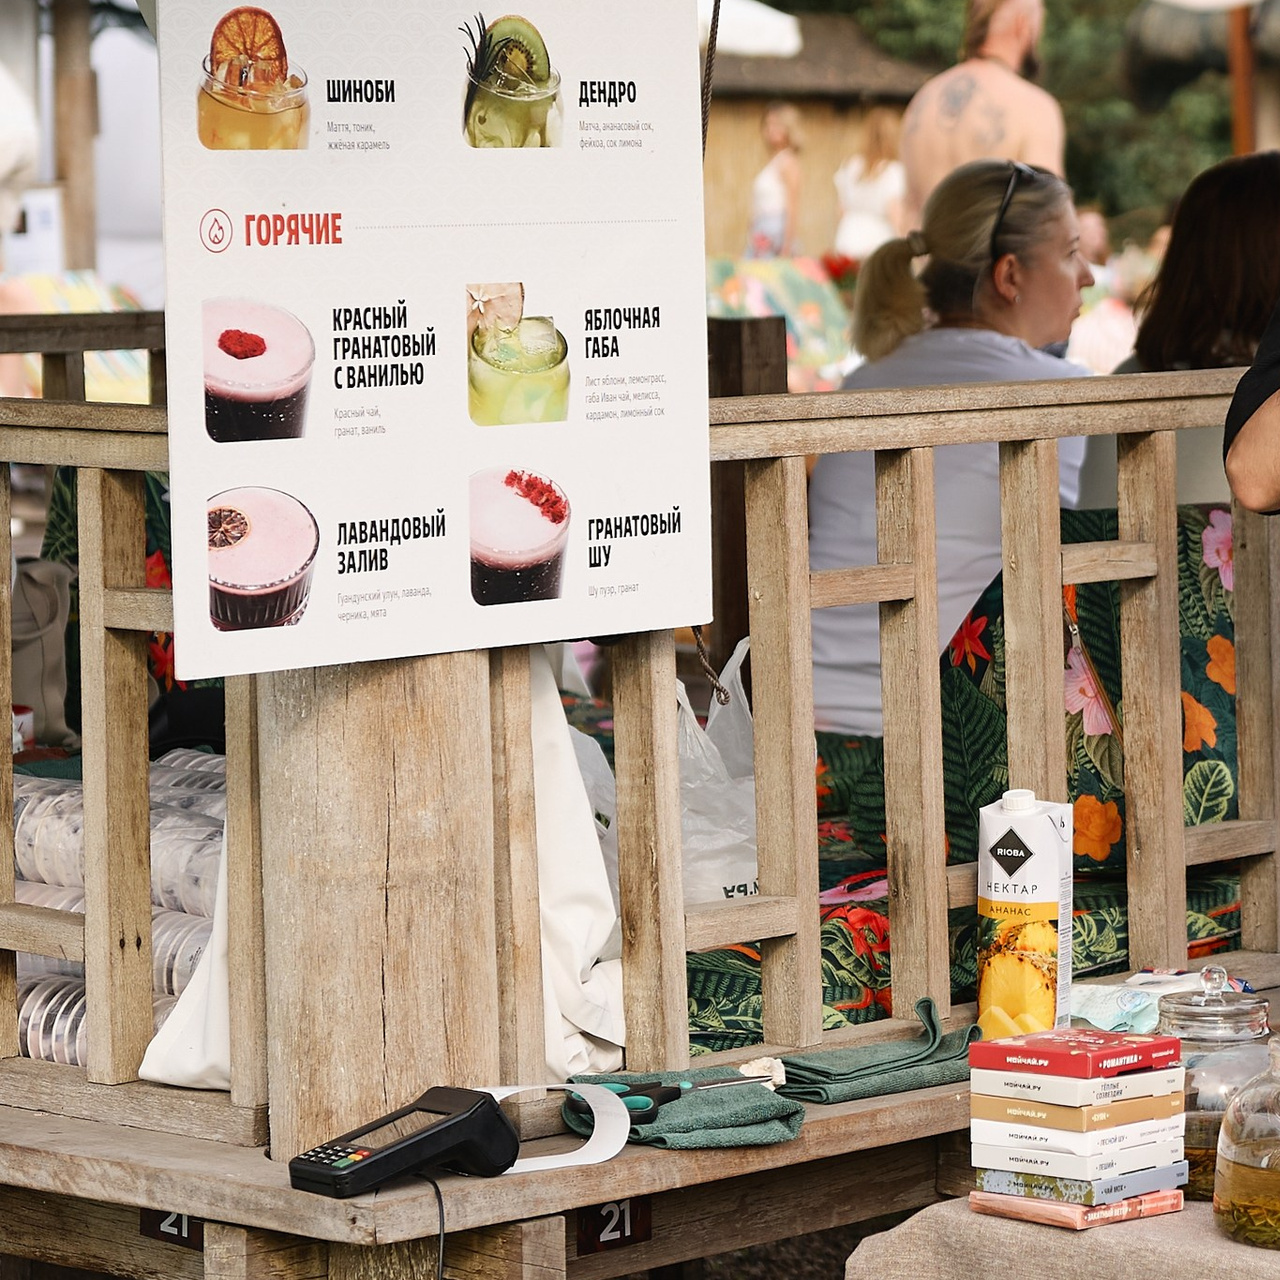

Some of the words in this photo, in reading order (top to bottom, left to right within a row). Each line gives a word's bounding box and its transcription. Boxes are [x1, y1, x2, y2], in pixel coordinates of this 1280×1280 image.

[326, 79, 395, 103] ШИНОБИ
[578, 81, 636, 108] ДЕНДРО
[352, 123, 375, 133] тоник,
[579, 121, 601, 133] Матча,
[602, 120, 640, 131] ананасовый
[641, 122, 654, 132] сок,
[328, 138, 355, 150] жжёная
[356, 141, 390, 152] карамель
[580, 137, 606, 151] фейхоа,
[606, 140, 617, 148] сок
[618, 140, 642, 148] лимона
[244, 211, 342, 247] ГОРЯЧИЕ
[333, 299, 407, 331] КРАСНЫЙ
[584, 306, 660, 331] ЯБЛОЧНАЯ
[333, 326, 436, 360] ГРАНАТОВЫЙ
[585, 335, 620, 359] ГАБА
[334, 366, 343, 389] С
[346, 362, 424, 388] ВАНИЛЬЮ
[585, 376, 600, 387] Лист
[601, 375, 627, 386] яблони,
[628, 374, 667, 386] лемонграсс,
[585, 392, 600, 403] габа
[601, 392, 617, 403] Иван
[618, 391, 631, 402] чай,
[632, 391, 661, 401] мелисса,
[334, 406, 365, 420] Красный
[366, 405, 381, 418] чай,
[585, 410, 619, 422] кардамон,
[620, 406, 653, 418] лимонный
[654, 407, 665, 416] сок
[334, 426, 360, 438] гранат,
[361, 425, 386, 435] ваниль
[337, 508, 445, 546] ЛАВАНДОВЫЙ
[588, 505, 681, 541] ГРАНАТОВЫЙ
[337, 548, 389, 575] ЗАЛИВ
[588, 545, 611, 568] ШУ
[337, 589, 381, 606] Гуандунский
[381, 590, 400, 602] улун,
[401, 587, 432, 598] лаванда,
[588, 586, 598, 598] Шу
[599, 586, 616, 597] пуэр,
[617, 583, 639, 595] гранат
[338, 610, 369, 623] черника,
[370, 608, 387, 618] мята
[996, 847, 1025, 858] RIOBA
[986, 881, 1038, 895] НЕКТАР
[989, 906, 1031, 916] АНАНАС
[1006, 1055, 1049, 1067] МОЙЧАЙ.РУ
[600, 1199, 631, 1242] 21
